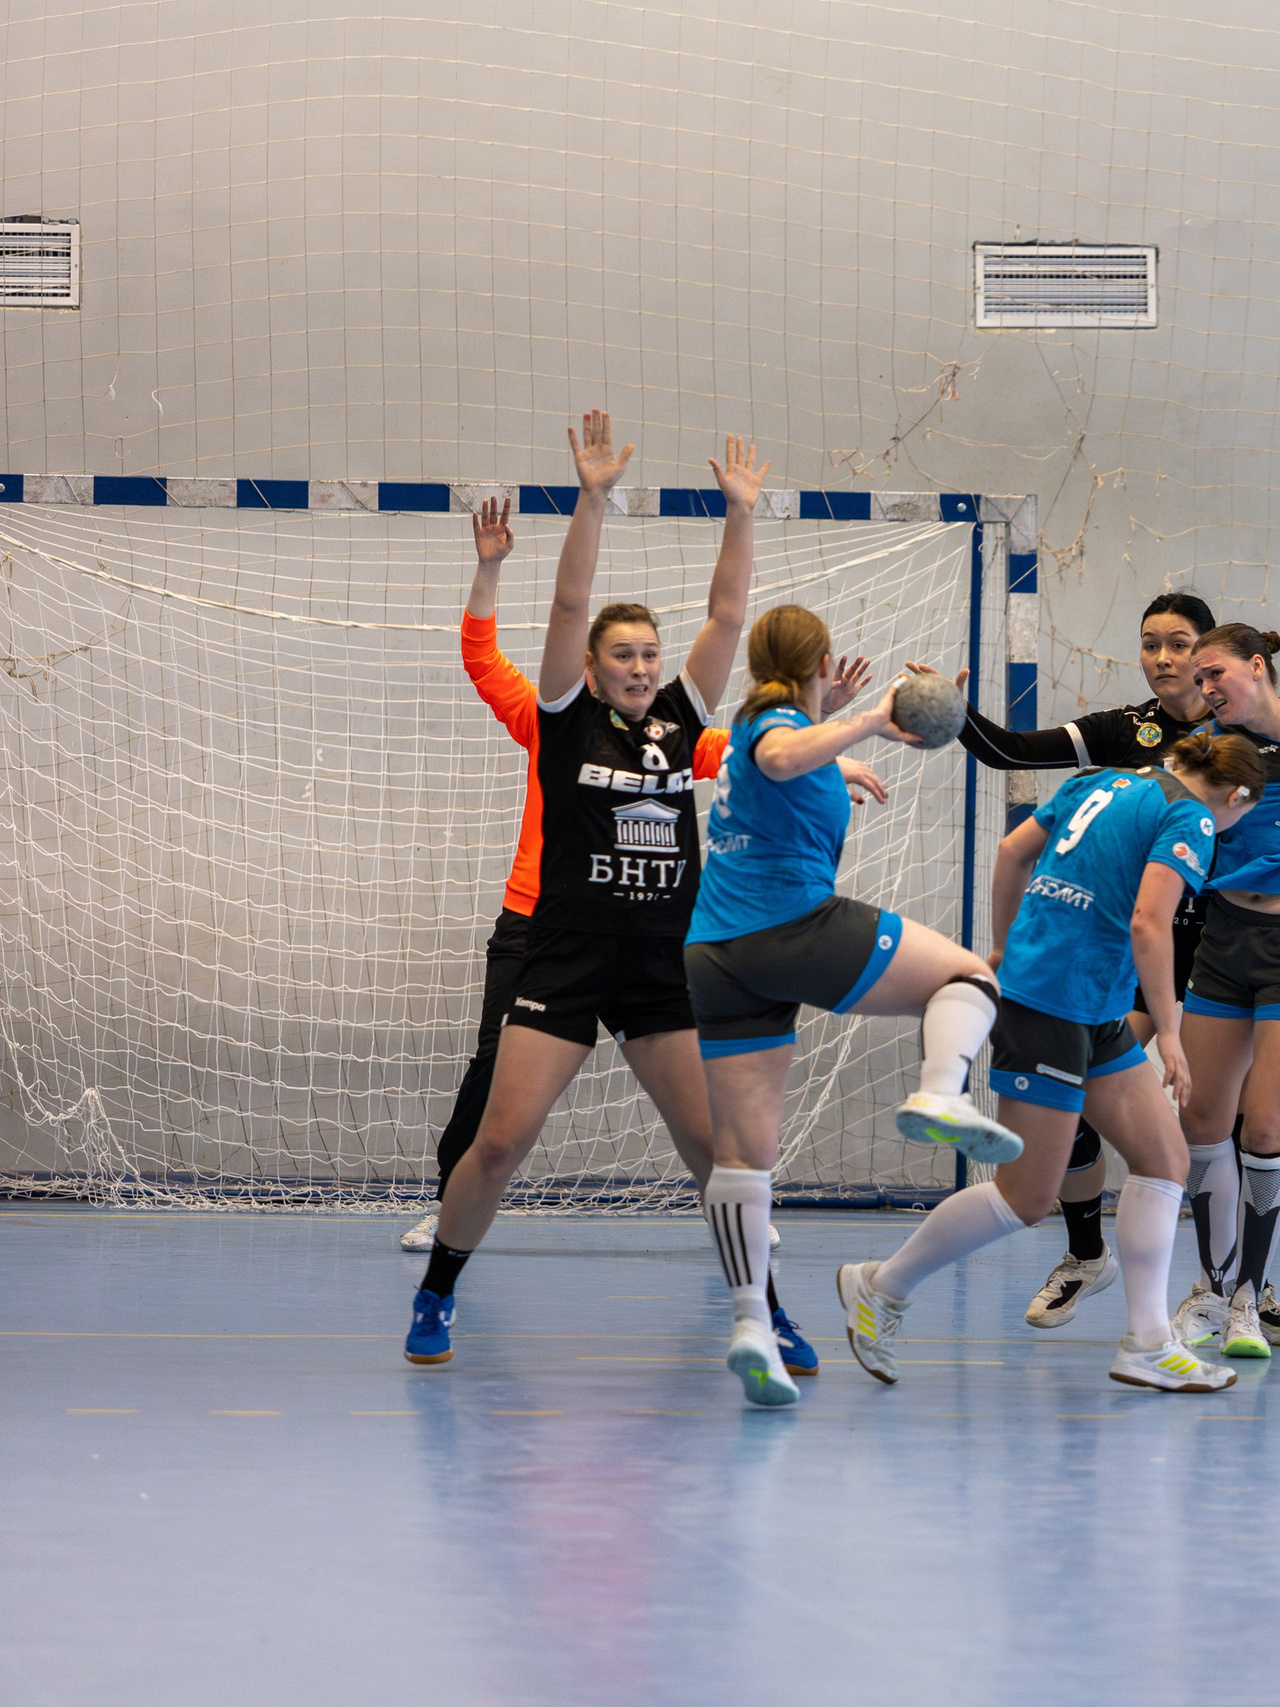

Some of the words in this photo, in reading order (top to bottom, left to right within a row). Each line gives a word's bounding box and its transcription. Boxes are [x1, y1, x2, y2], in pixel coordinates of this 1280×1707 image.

[1054, 788, 1114, 855] 9
[588, 854, 687, 888] БНТУ
[514, 996, 547, 1012] Kempa
